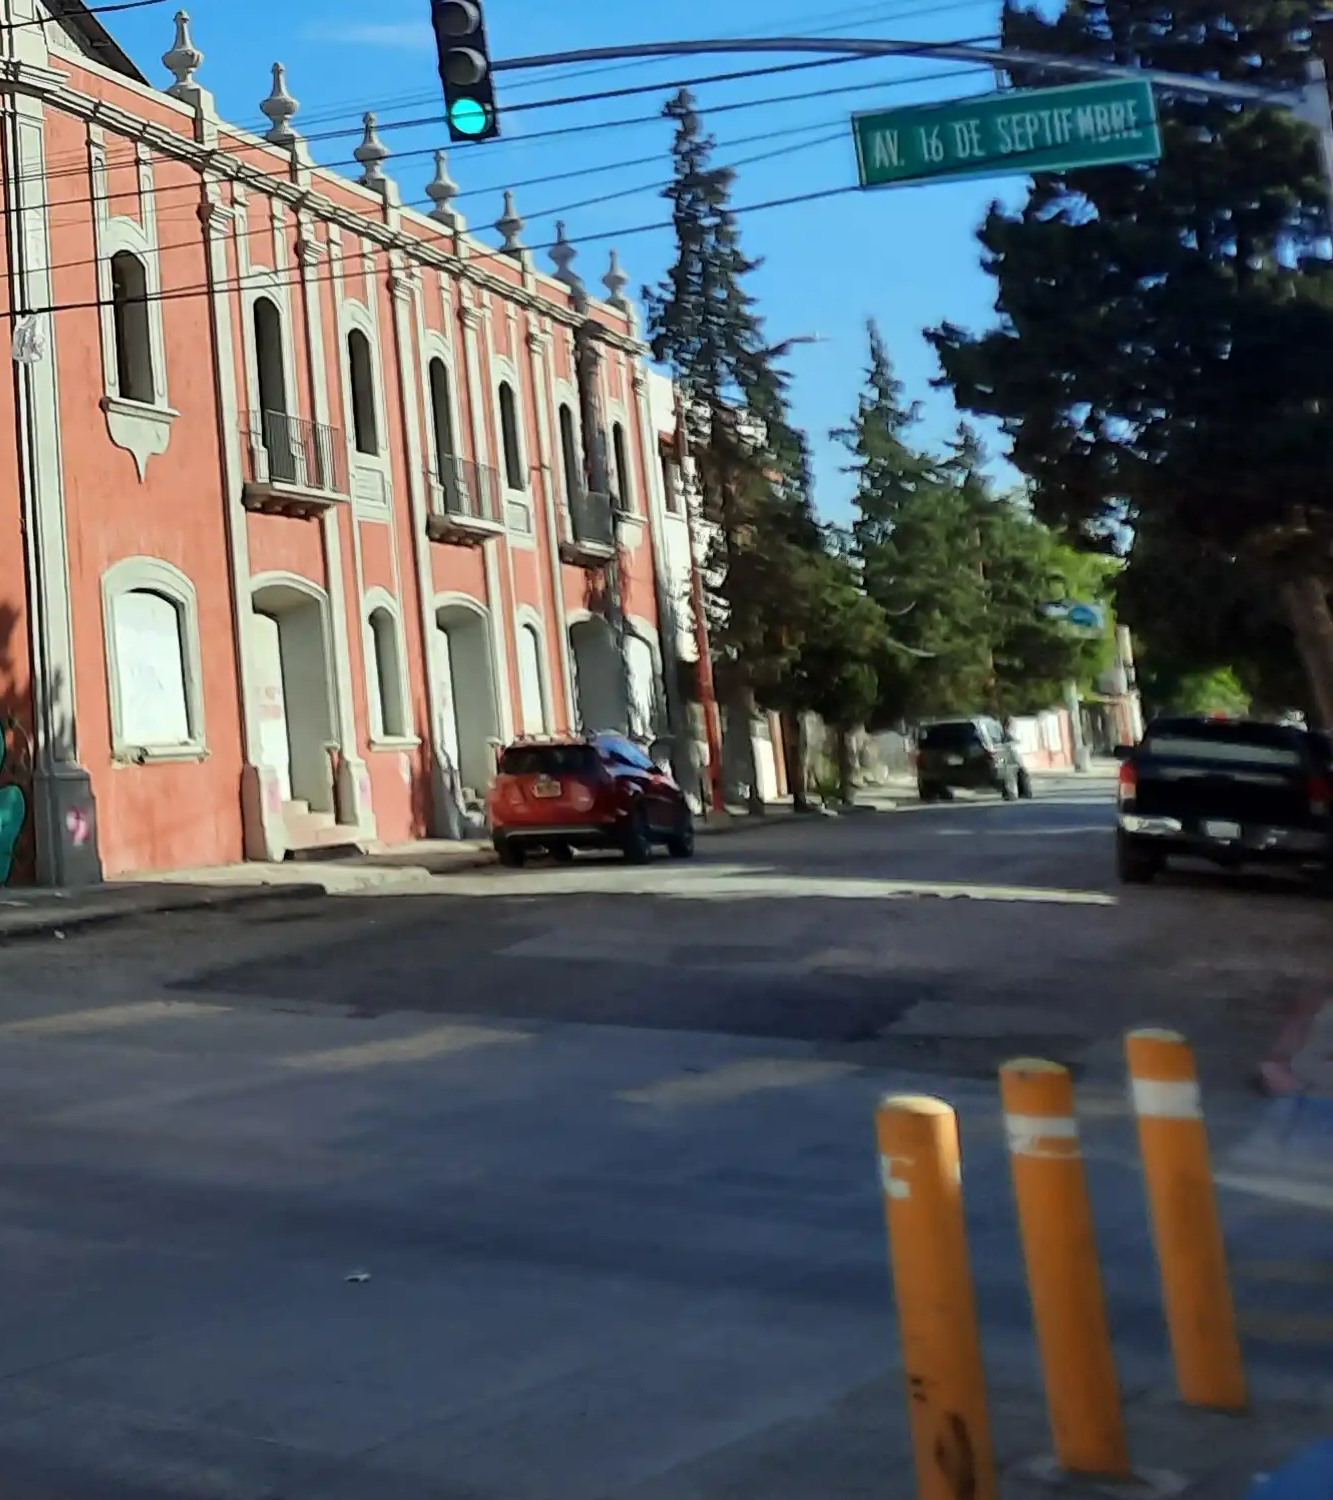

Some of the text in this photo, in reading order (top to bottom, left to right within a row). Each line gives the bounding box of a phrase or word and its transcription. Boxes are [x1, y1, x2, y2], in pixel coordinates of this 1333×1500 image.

[873, 99, 1147, 169] AV. 16 DE SEPTIEMBRE
